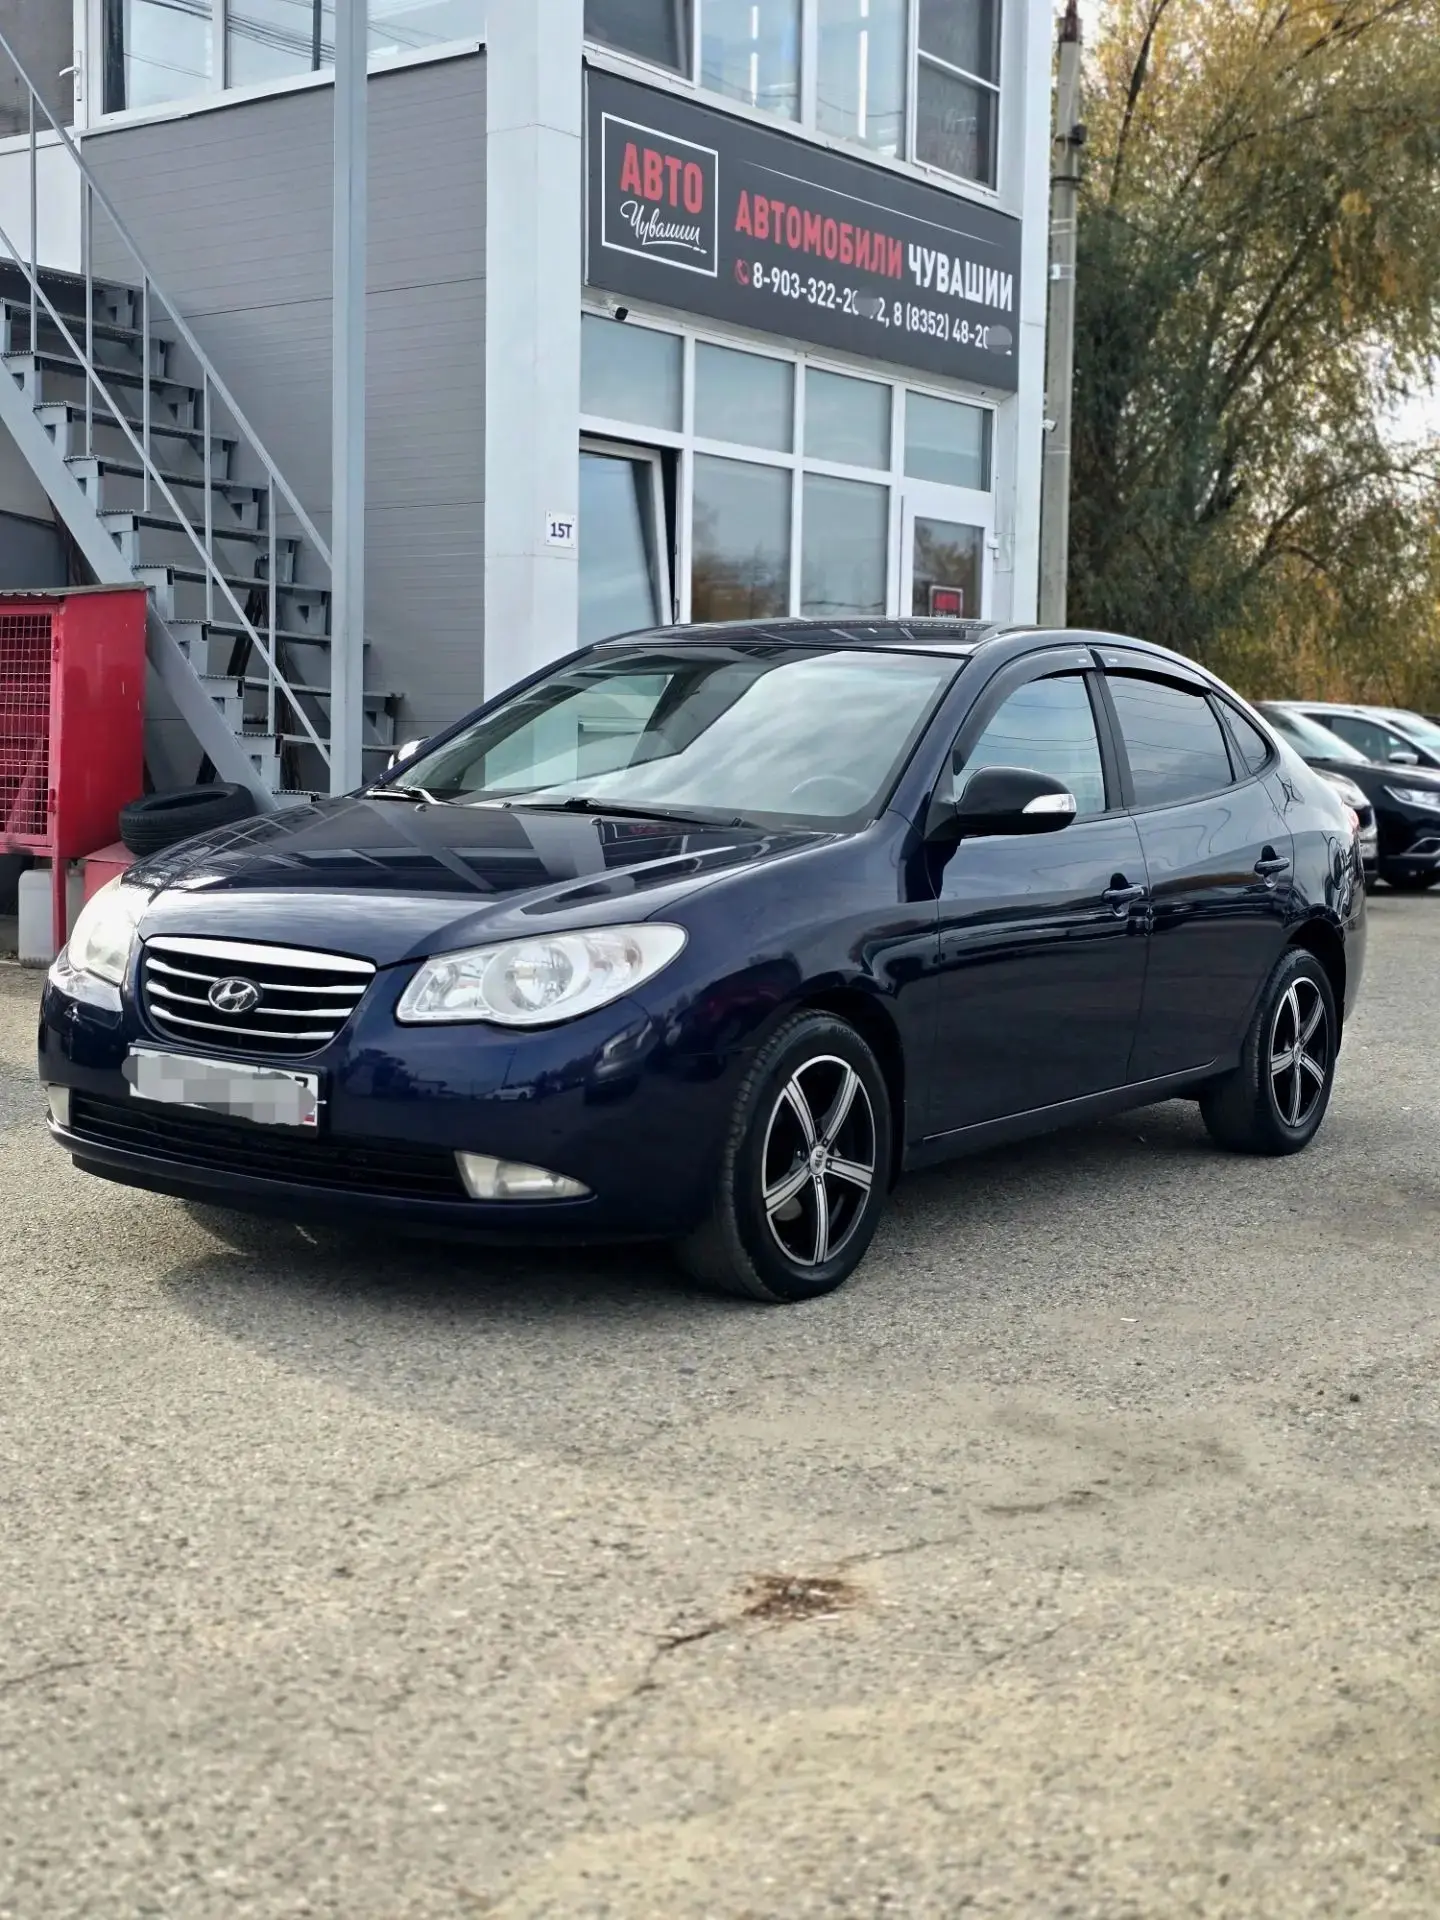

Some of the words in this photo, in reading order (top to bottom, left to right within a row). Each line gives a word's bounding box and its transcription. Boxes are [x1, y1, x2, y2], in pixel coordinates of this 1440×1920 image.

[620, 142, 703, 214] АВТО
[620, 200, 708, 254] Чувашии
[735, 190, 903, 280] АВТОМОБИЛИ
[908, 243, 1013, 312] ЧУВАШИИ
[893, 301, 902, 326] 8
[906, 302, 950, 341] (8352)
